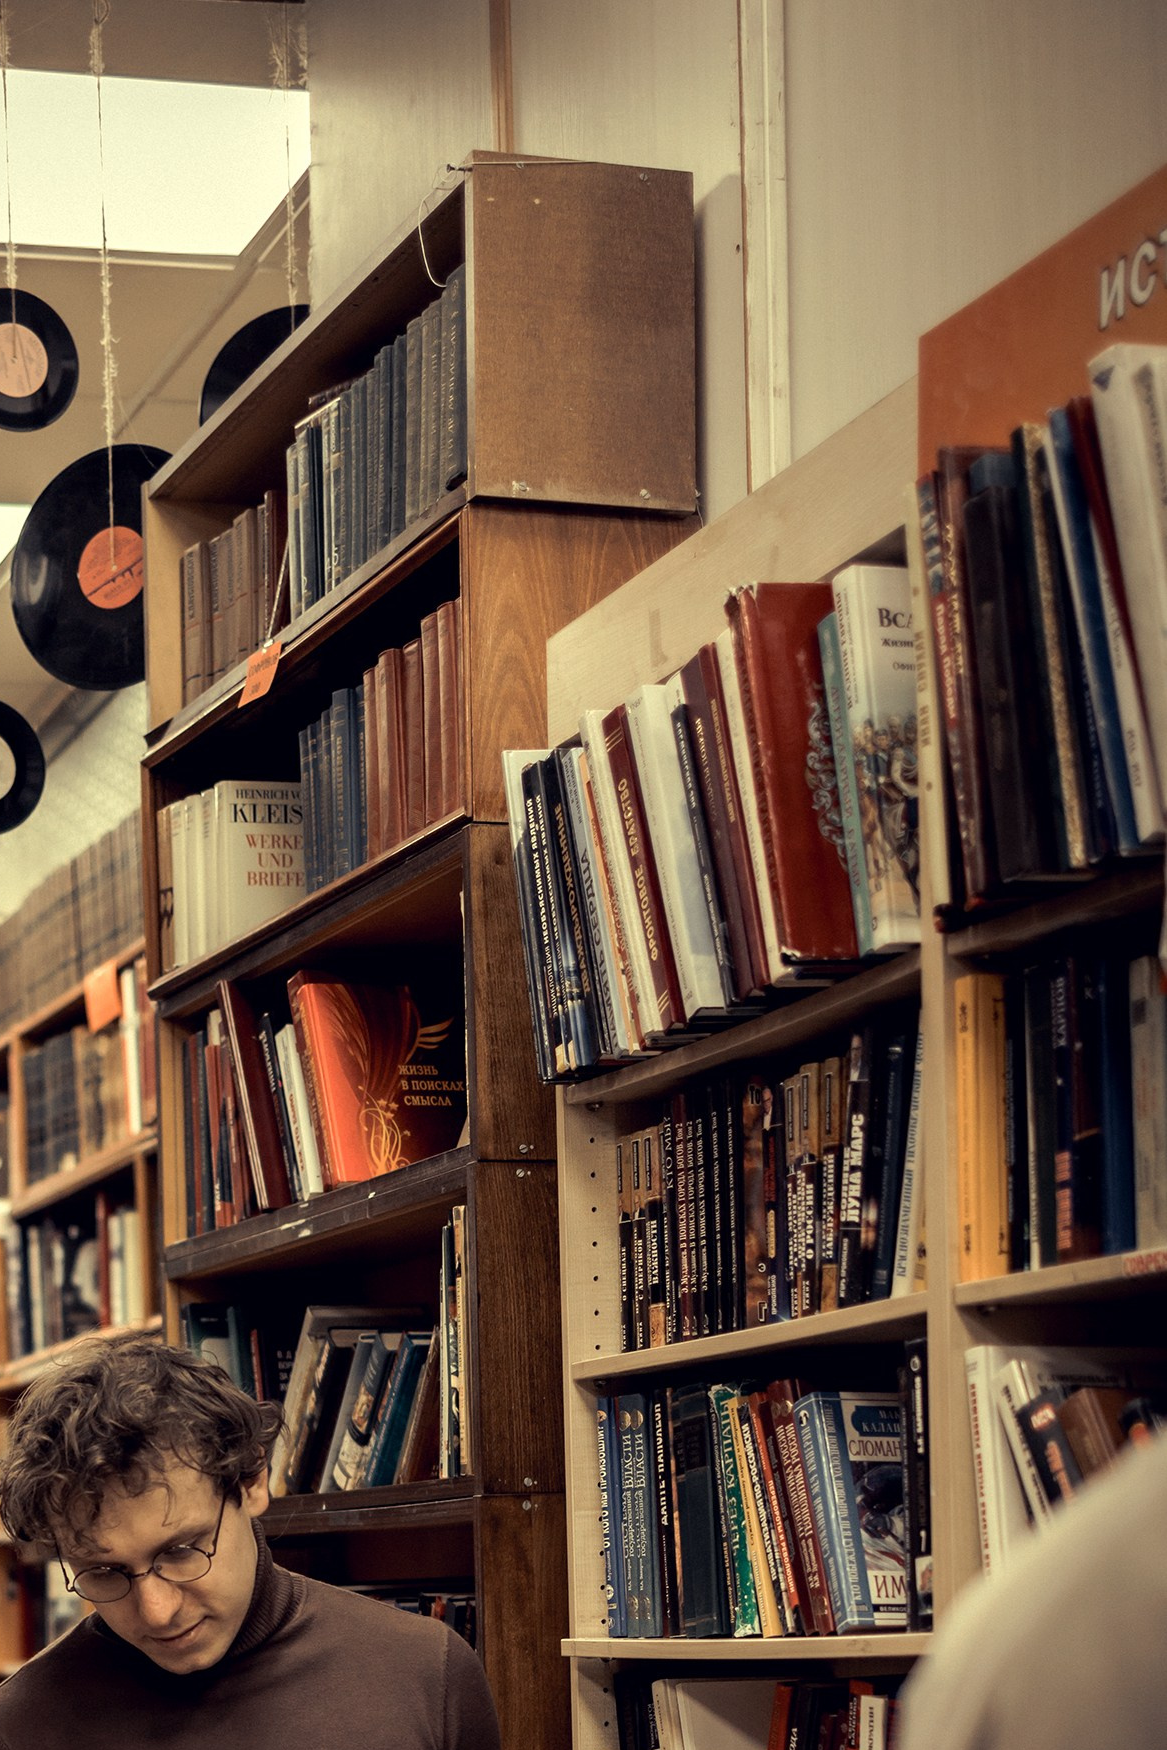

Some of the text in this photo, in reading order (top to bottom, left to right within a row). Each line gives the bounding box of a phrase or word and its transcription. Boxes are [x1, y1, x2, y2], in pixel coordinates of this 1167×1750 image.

[236, 789, 288, 799] HEINRICH
[246, 834, 303, 850] WERKE
[258, 853, 293, 868] UND
[534, 793, 561, 939] НЕОБЪЯСНИМЫХ ЯВЛЕНИЙ
[247, 871, 305, 887] BRIEFE
[616, 777, 660, 960] ФРОНТОВОЕ БРАТСТВО
[525, 796, 559, 1016] ЭНЦИКЛОПЕДИЯ НЕОБЪЯСНИМЫХ ЯВЛЕНИЙ
[553, 802, 591, 992] ДВАЖДЫРОЖДЕННЫЕ
[579, 848, 603, 945] СЕРДЦА
[398, 1064, 439, 1075] ЖИЗНЬ
[401, 1080, 465, 1092] В ПОИСКАХ
[404, 1095, 453, 1107] СМЫСЛА
[662, 1115, 675, 1189] КТО МЫ?
[675, 1126, 683, 1140] Том
[675, 1140, 685, 1168] БОГОВ.
[685, 1124, 693, 1137] Том
[685, 1138, 694, 1166] БОГОВ.
[695, 1121, 703, 1136] Том
[695, 1136, 704, 1165] БОГОВ.
[711, 1130, 719, 1158] БОГОВ.
[675, 1169, 686, 1200] ГОРОДА
[686, 1169, 695, 1199] ГОРОДА
[696, 1166, 705, 1197] ГОРОДА
[727, 1156, 735, 1187] ГОРОДА
[838, 1146, 851, 1221] СОЛНЦЕ
[845, 1112, 865, 1222] ЛУНА МАРС
[678, 1202, 687, 1239] ПОИСКАХ
[687, 1200, 696, 1238] ПОИСКАХ
[698, 1198, 707, 1237] ПОИСКАХ
[713, 1193, 721, 1230] ПОИСКАХ
[801, 1183, 817, 1259] О РОССИИ
[824, 1153, 835, 1258] ЗАБЛУЖДЕНИЙ
[635, 1238, 645, 1290] АМЕРИКОЙ
[650, 1219, 659, 1284] ВАЖНОСТИ
[597, 1424, 610, 1547] ОТ КОГО МЫ ПРОИЗОШЛИ?
[621, 1433, 633, 1488] ВЛАСТИ
[633, 1433, 645, 1488] ВЛАСТИ
[719, 1400, 740, 1554] ЧЕРЕЗ КАРПАТЫ
[775, 1425, 804, 1538] ГЕОПОЛИТИКА РОССИИ
[783, 1423, 813, 1536] ГЕОПОЛИТИКА РОССИИ
[740, 1421, 778, 1580] ПРИВАТИЗАЦИЯ ПО-РОССИЙСКИ
[799, 1425, 831, 1558] СЛОМАННЫЙ МЕЧ ИМПЕРИИ
[823, 1402, 862, 1601] КТО МИРОВОЙ ХОЛОДНОЙ ВОЙНЕ?
[625, 1490, 635, 1556] государственной
[637, 1490, 647, 1556] государственной
[766, 1480, 783, 1533] ПЕРЕВОРОТЫ
[779, 1542, 795, 1593] РЕВОЛЮЦИИ
[721, 1541, 730, 1566] БЕЛЯЕВ
